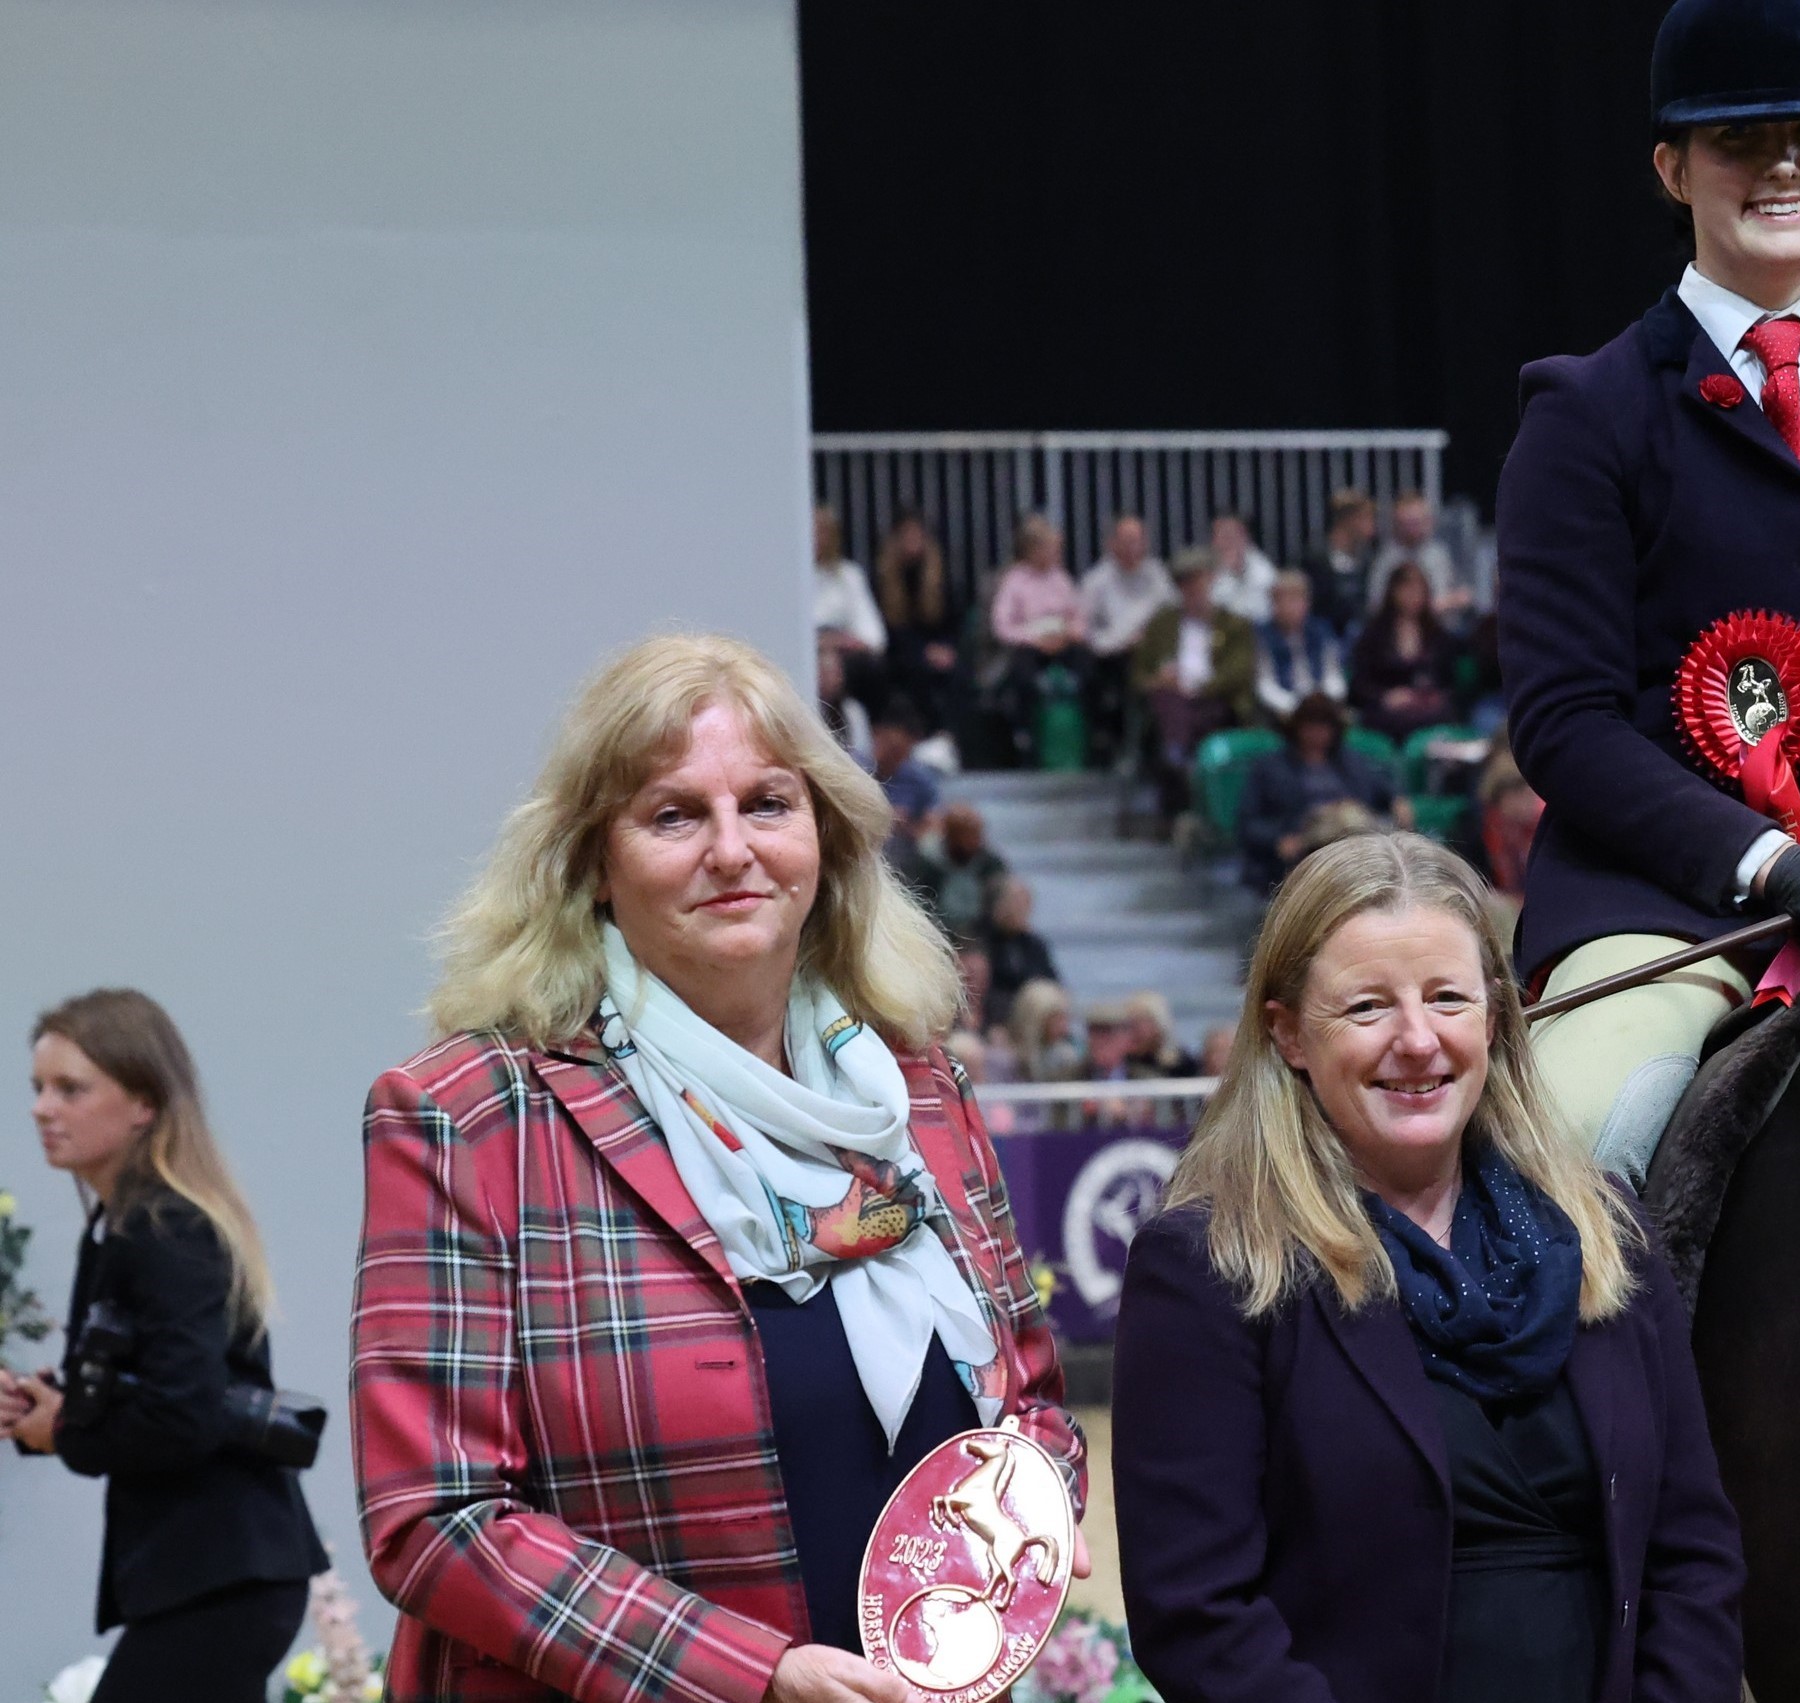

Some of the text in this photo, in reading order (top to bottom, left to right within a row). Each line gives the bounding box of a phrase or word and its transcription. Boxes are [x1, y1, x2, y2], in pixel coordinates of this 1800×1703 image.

[888, 1534, 947, 1572] 2023
[864, 1593, 886, 1653] HORSE
[993, 1632, 1037, 1686] SHOW
